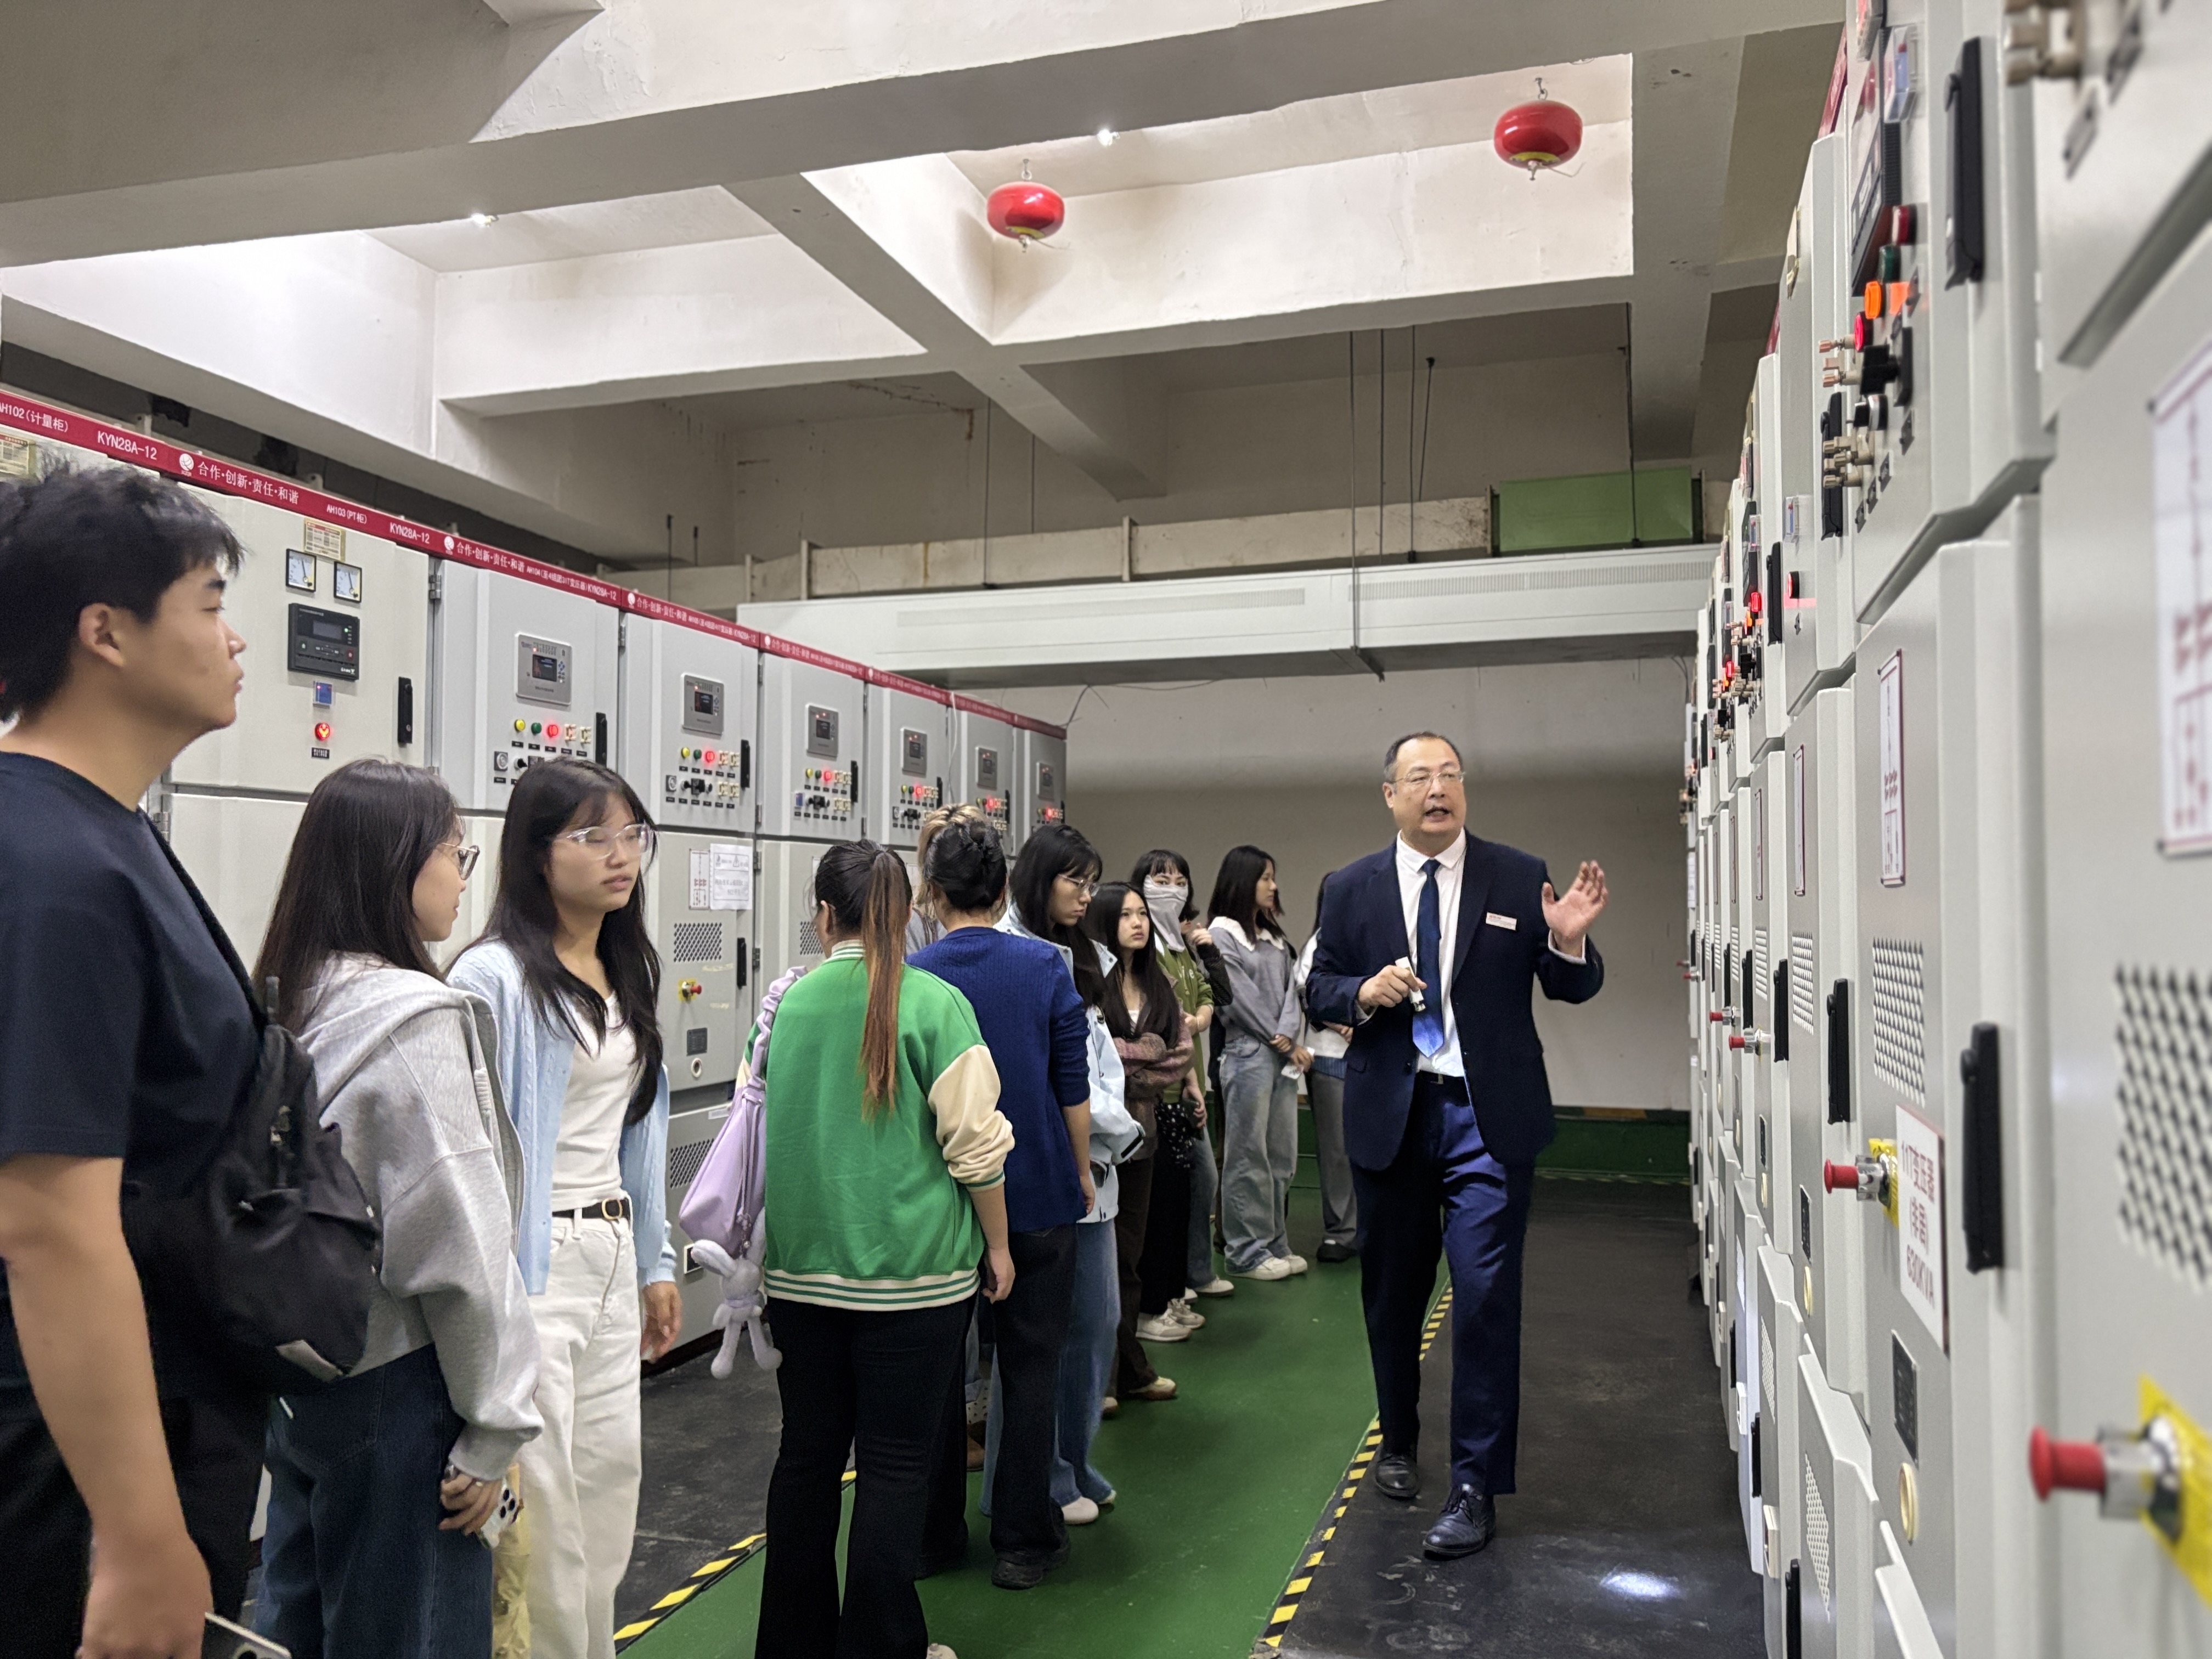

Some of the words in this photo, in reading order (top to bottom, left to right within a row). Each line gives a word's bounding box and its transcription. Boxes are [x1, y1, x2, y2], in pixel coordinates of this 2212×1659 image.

[98, 431, 157, 460] KYN28A-12
[390, 522, 430, 544] KYN28A-12
[588, 583, 617, 601] KYN28A-12
